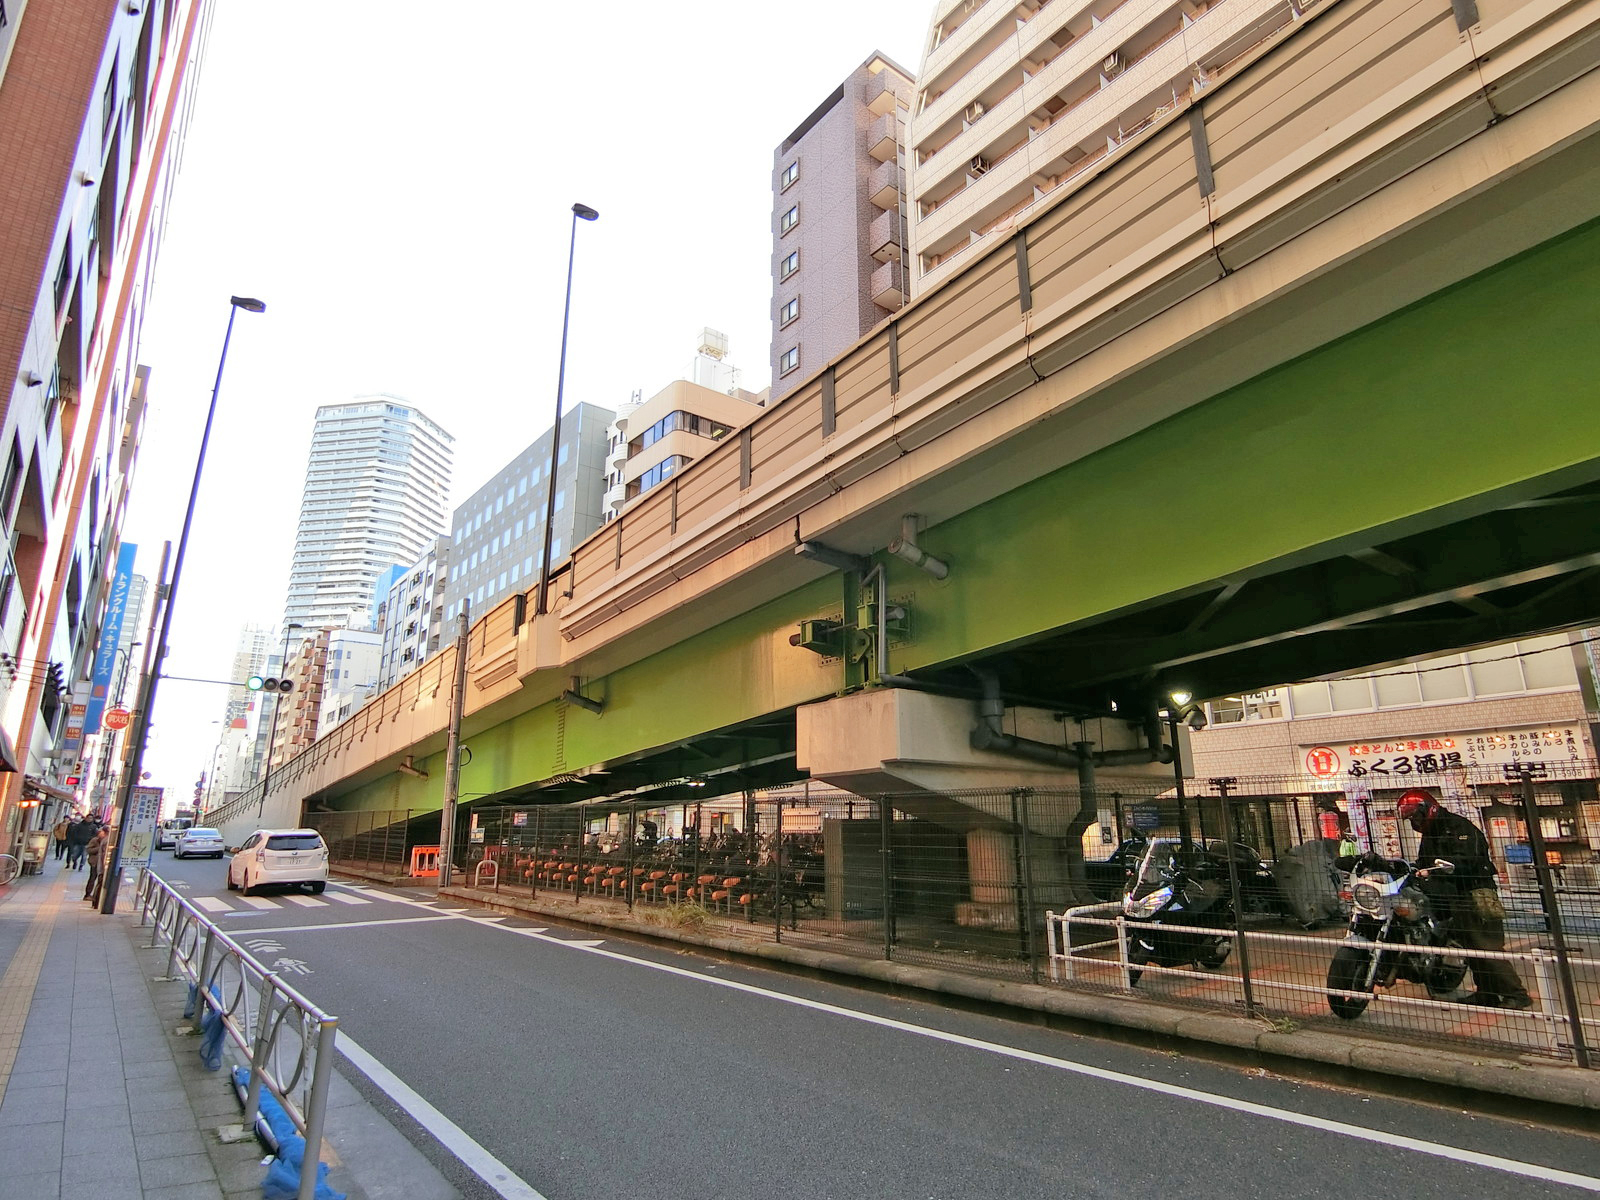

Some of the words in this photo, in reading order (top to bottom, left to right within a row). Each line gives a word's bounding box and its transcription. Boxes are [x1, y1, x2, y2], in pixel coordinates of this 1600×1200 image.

[98, 572, 128, 676] トランクルーム・キュラーズ
[107, 714, 129, 725] 消火栓
[1519, 733, 1531, 756] かしら
[1564, 729, 1580, 760] 牛煮込み
[1348, 751, 1463, 778] ぶくろ酒場
